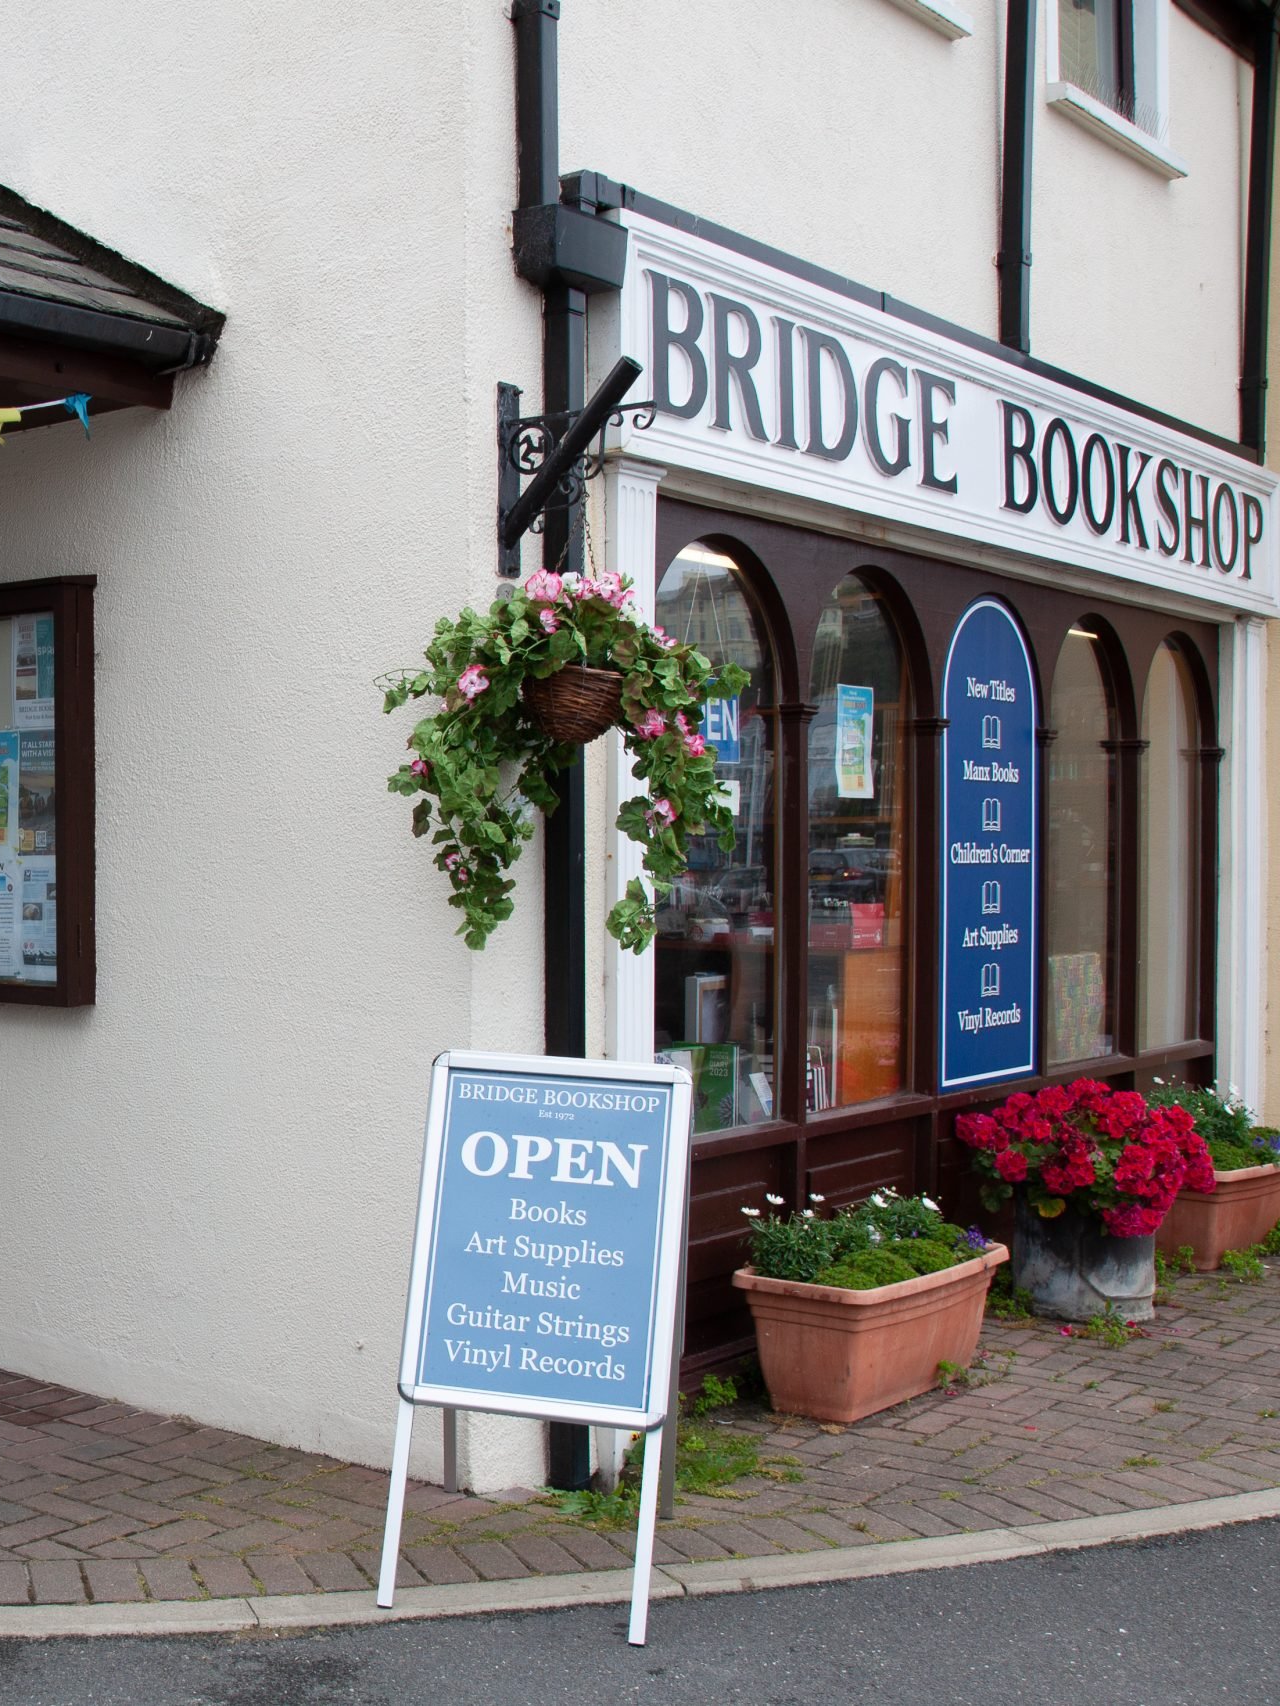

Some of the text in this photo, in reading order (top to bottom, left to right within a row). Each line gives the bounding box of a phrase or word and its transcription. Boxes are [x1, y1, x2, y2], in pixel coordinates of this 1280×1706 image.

[644, 268, 1265, 581] BRIDGE BOOKSHOP
[966, 677, 1015, 703] New Titles
[697, 696, 738, 742] EN
[962, 760, 1019, 783] Manx Books
[999, 843, 1030, 863] Corner
[962, 924, 1018, 951] Art Supplies
[957, 1002, 1020, 1033] Vinyl Records
[709, 1068, 729, 1077] 2023
[458, 1083, 660, 1113] BRIDGE BOOKSHOP
[538, 1109, 575, 1121] Est 1972
[460, 1130, 648, 1189] OPEN
[509, 1198, 587, 1226] Books
[464, 1231, 625, 1267] Art Supplies
[501, 1271, 581, 1300] Music
[446, 1303, 630, 1347] Guitar Strings
[443, 1338, 626, 1381] Vinyl Records
